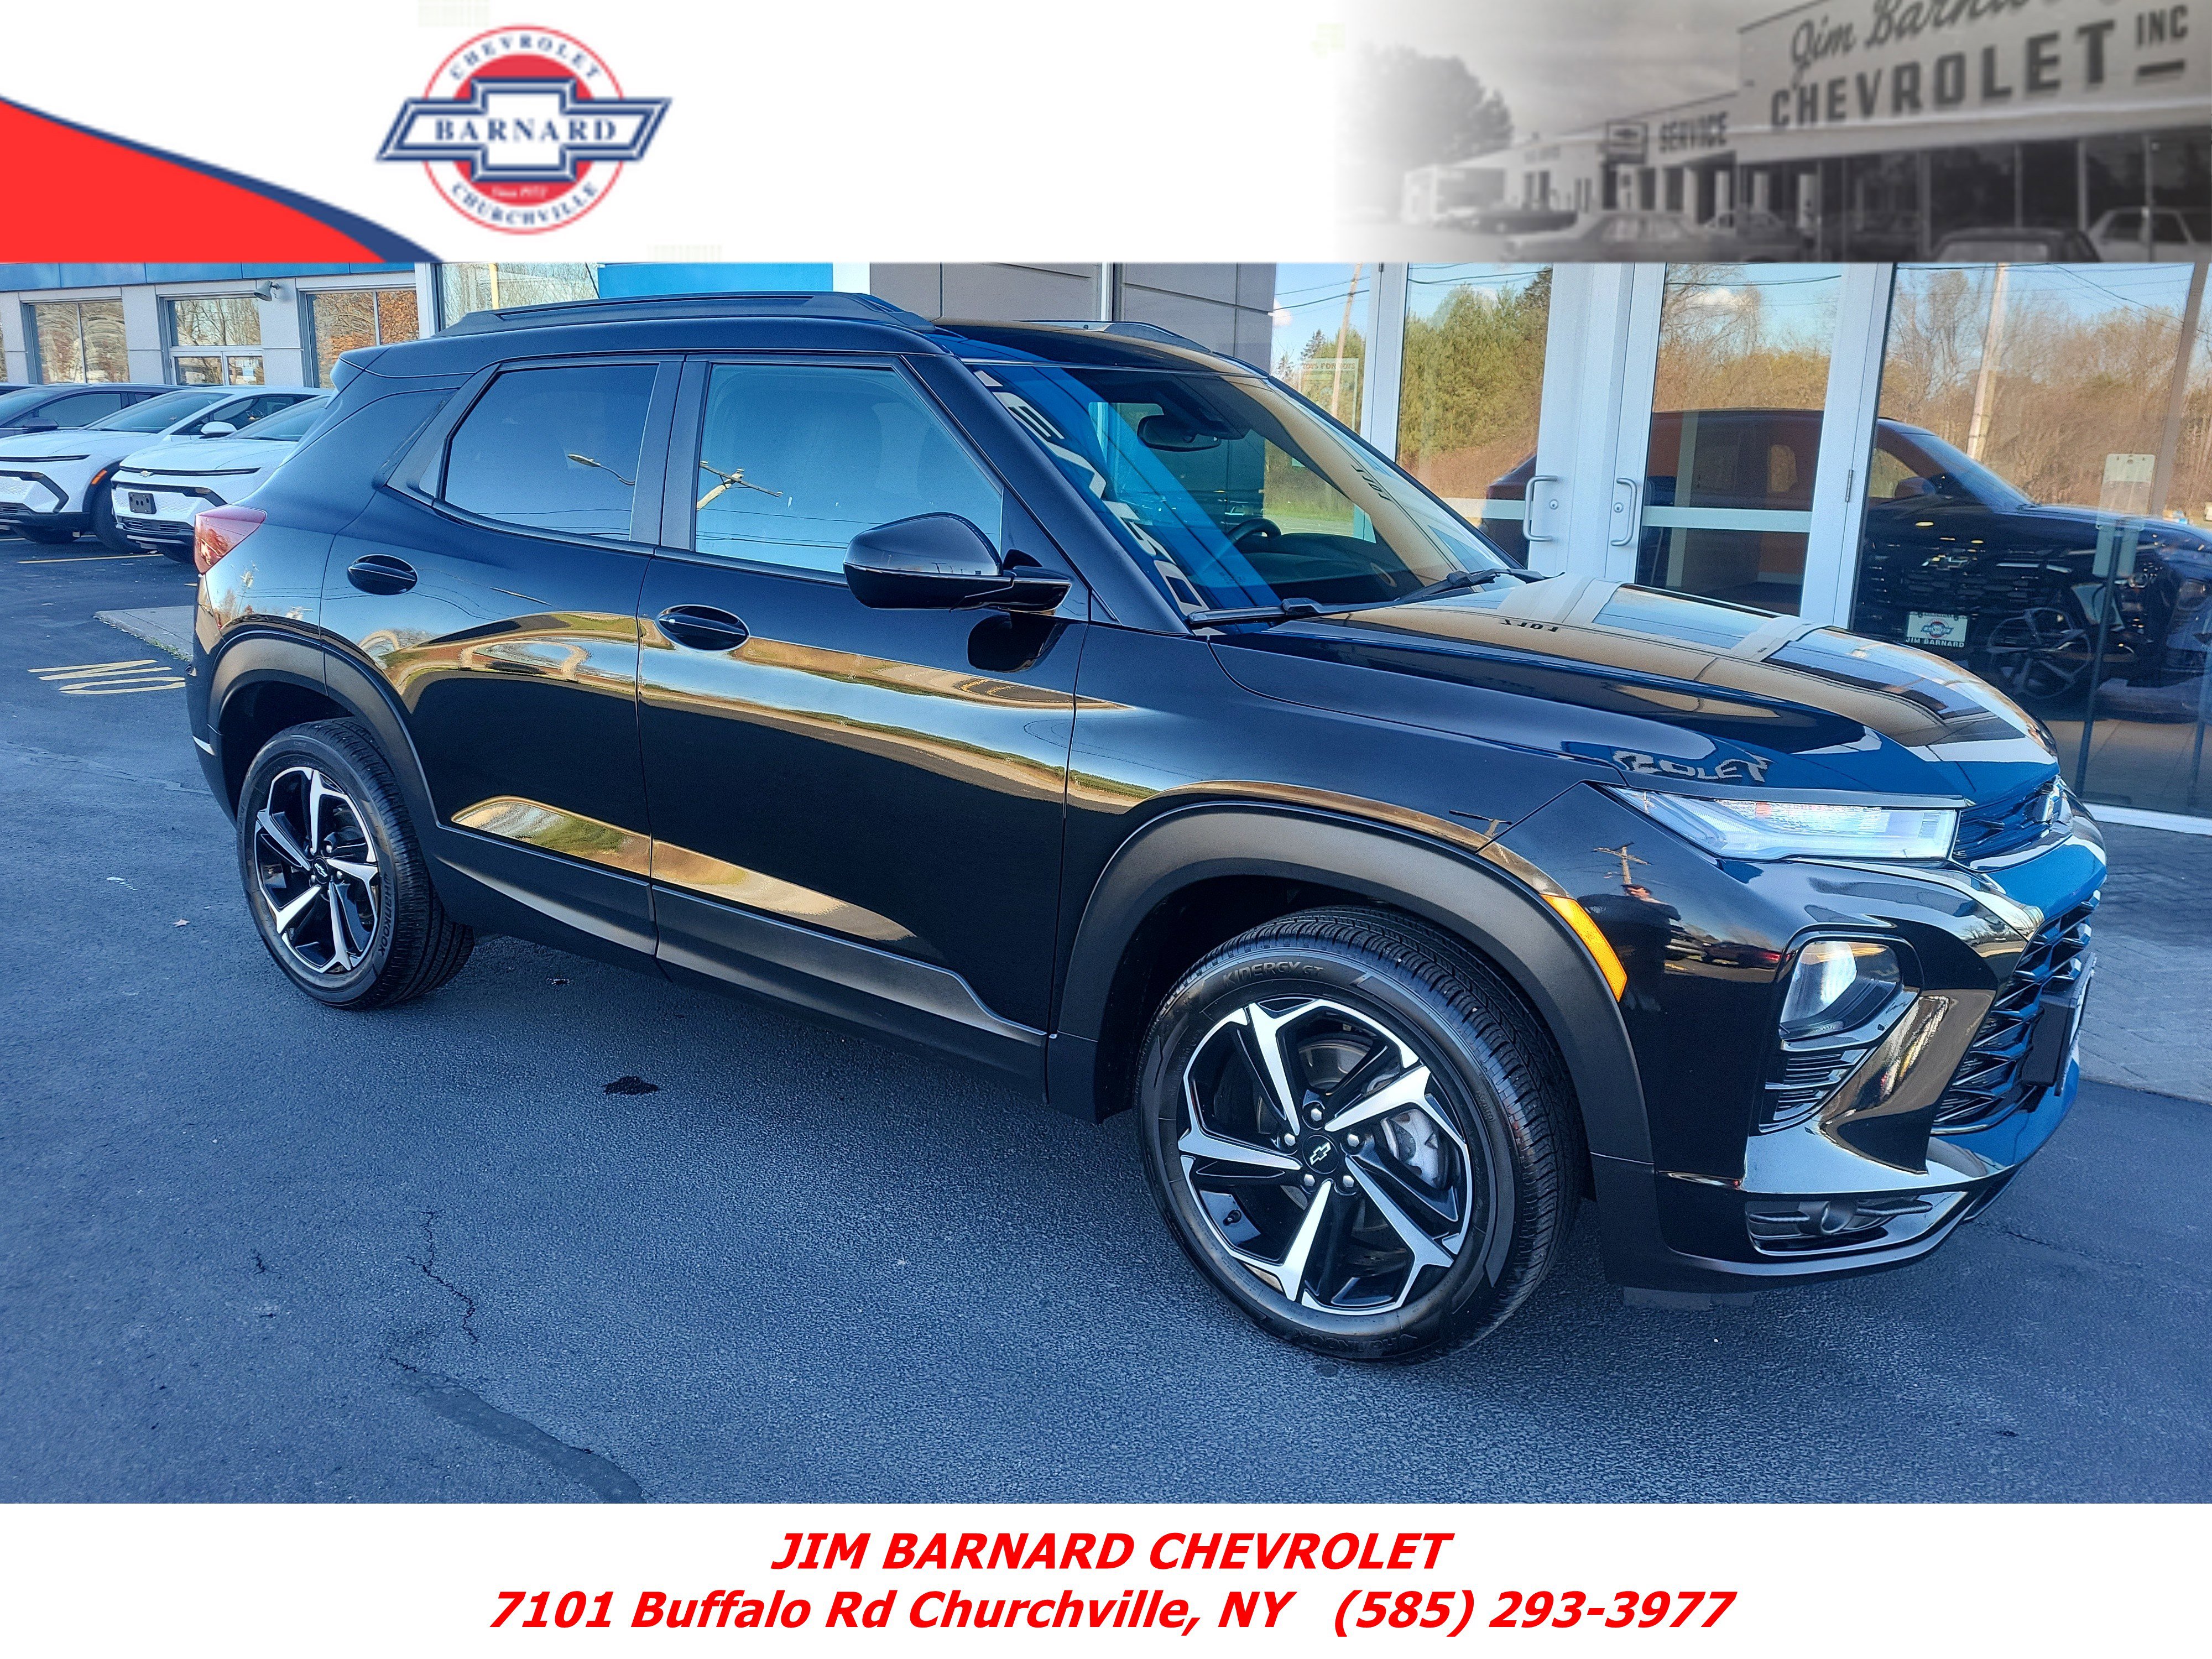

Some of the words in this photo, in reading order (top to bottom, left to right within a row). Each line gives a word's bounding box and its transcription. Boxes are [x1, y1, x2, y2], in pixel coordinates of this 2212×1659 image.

[1923, 639, 1965, 648] BARNARD
[1223, 961, 1301, 987] KINERGY
[1302, 964, 1324, 978] GT
